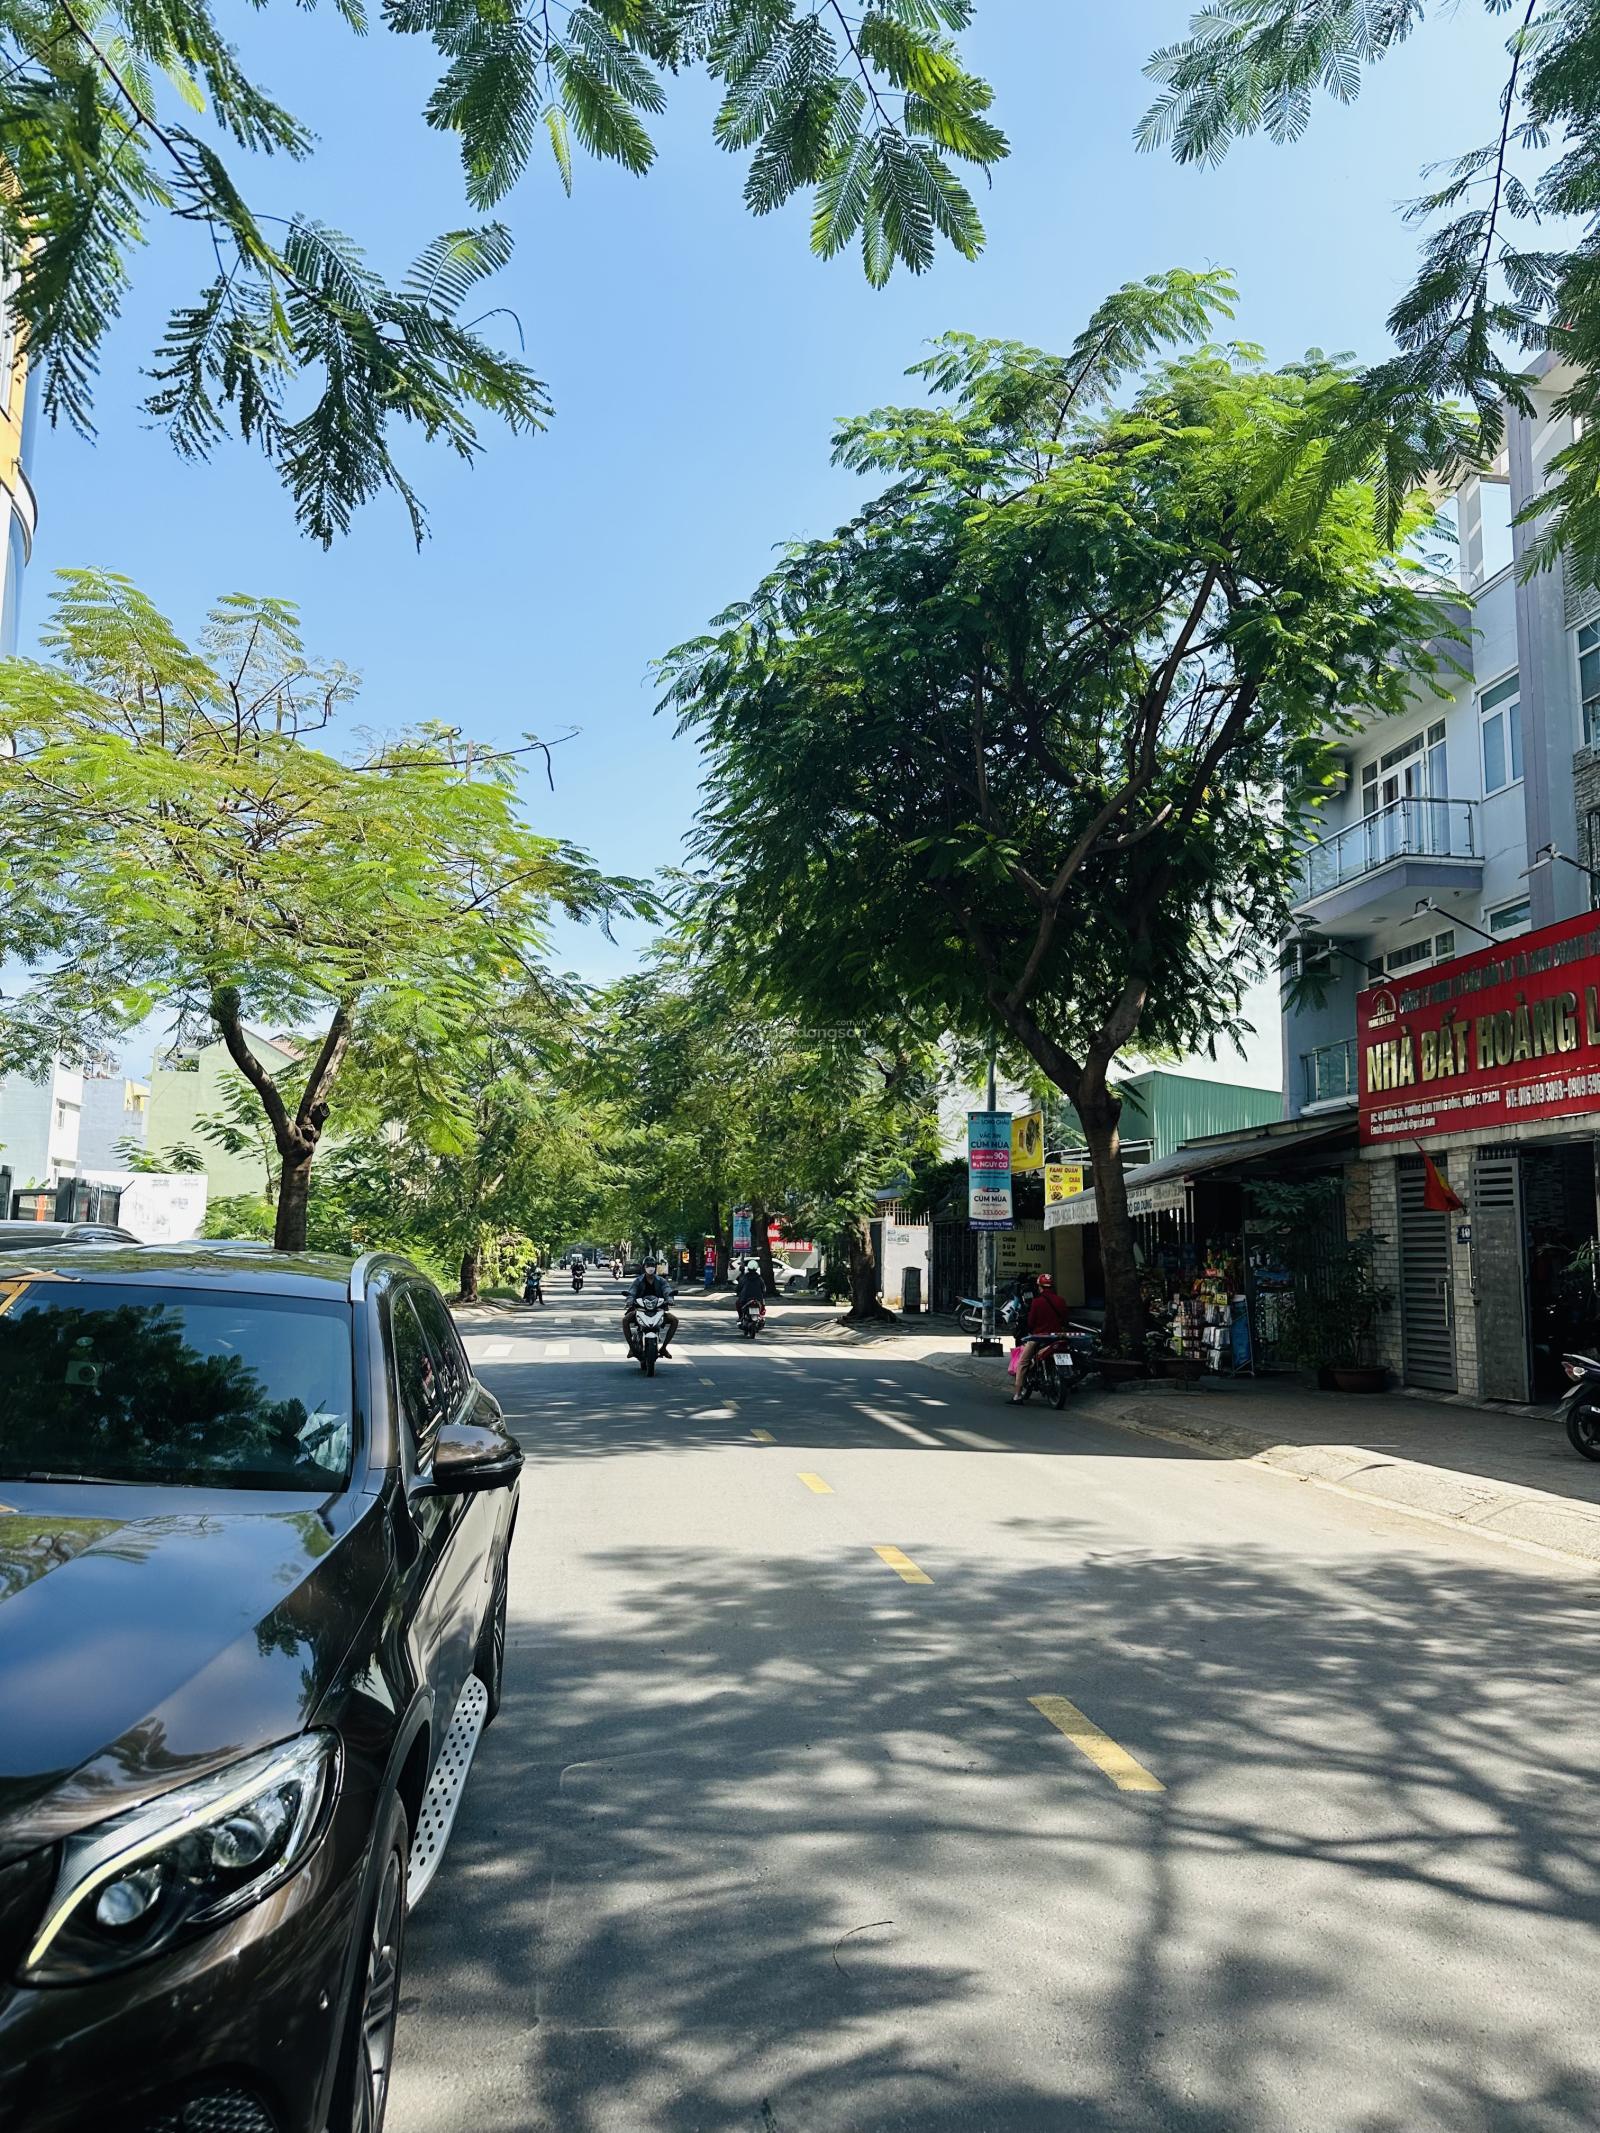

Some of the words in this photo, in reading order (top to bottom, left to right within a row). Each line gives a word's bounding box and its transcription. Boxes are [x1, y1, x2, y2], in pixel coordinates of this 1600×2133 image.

[1366, 1026, 1415, 1093] NHÀ
[1421, 1007, 1469, 1082] ĐẤT
[1475, 991, 1579, 1070] HOÀNG
